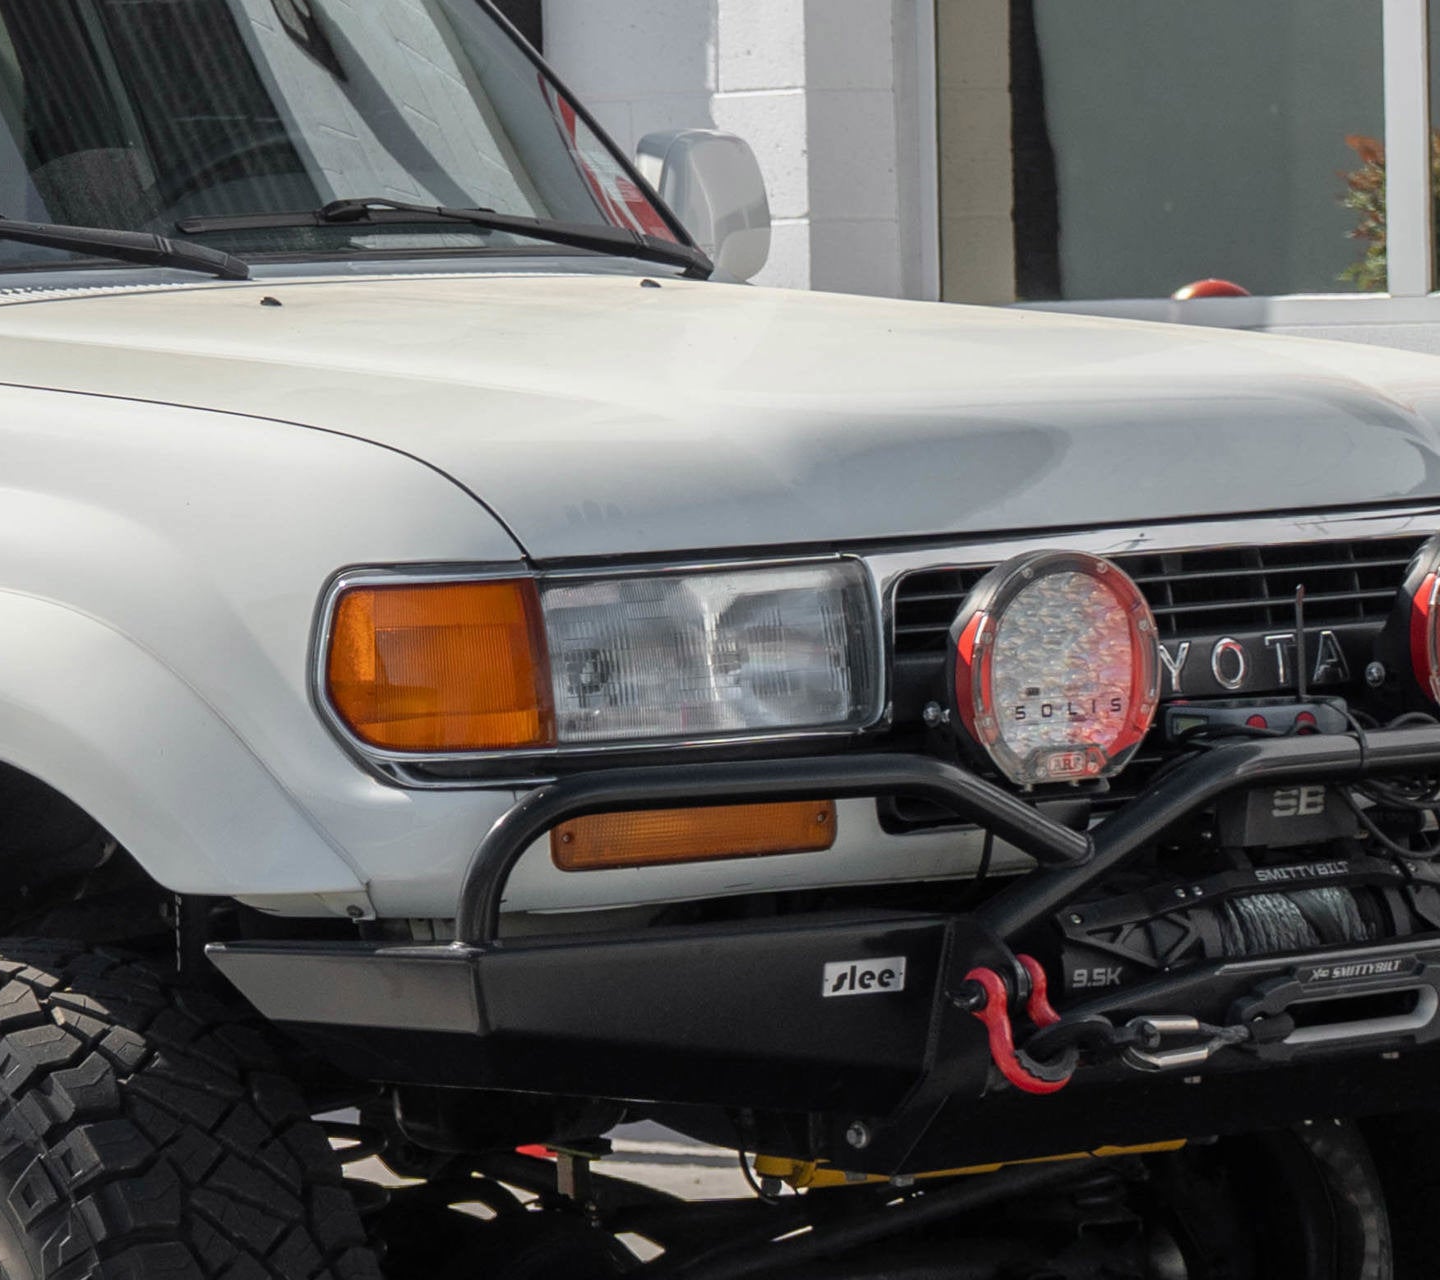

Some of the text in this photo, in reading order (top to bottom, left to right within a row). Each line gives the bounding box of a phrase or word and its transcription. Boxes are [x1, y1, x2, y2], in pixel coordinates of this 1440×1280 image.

[1158, 630, 1351, 695] YOTA
[1014, 697, 1122, 721] SOLIS
[1254, 861, 1349, 882] SMITTYBILT
[831, 964, 896, 993] slee
[1072, 966, 1123, 988] 9.5K
[1331, 959, 1401, 979] SMITTYBILT
